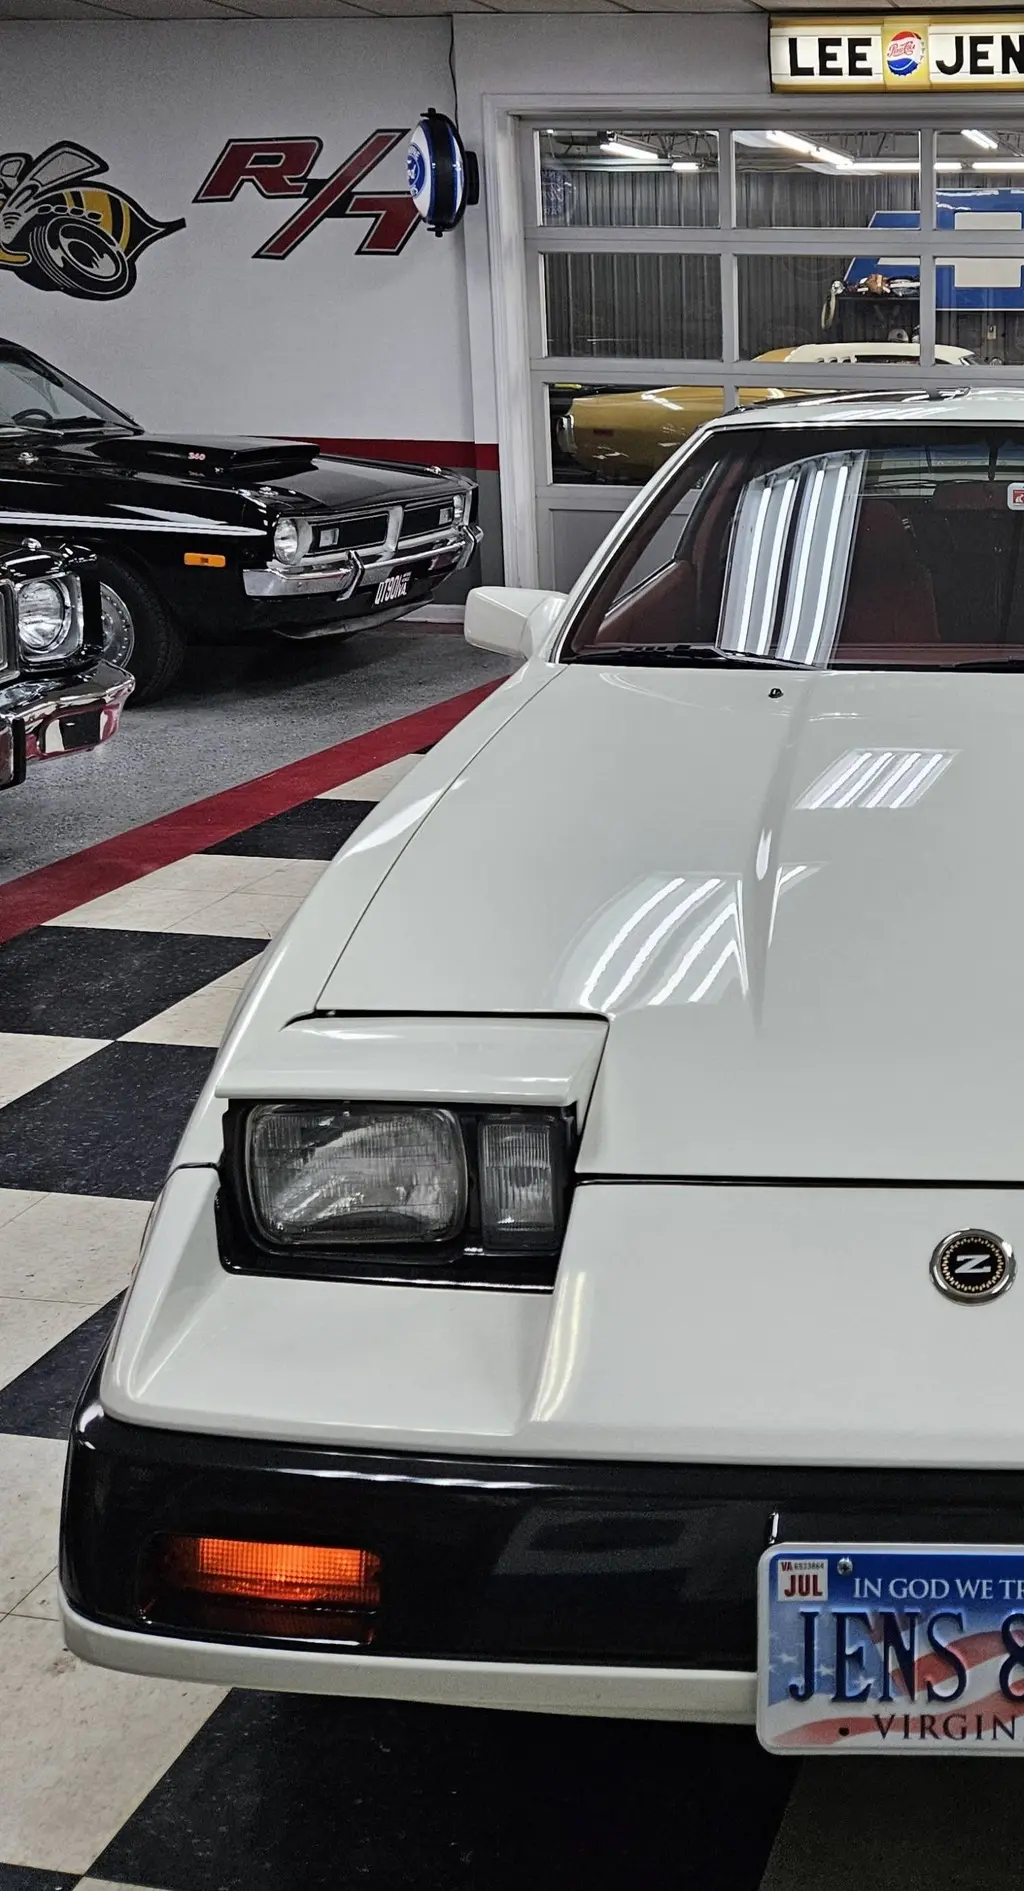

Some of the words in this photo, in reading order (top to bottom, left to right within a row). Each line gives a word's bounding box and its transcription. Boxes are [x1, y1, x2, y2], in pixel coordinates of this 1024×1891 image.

[788, 37, 873, 76] LEE
[192, 128, 421, 260] R/T
[954, 1254, 992, 1274] Z
[781, 1561, 793, 1571] VA
[784, 1574, 823, 1597] JUL
[853, 1578, 881, 1599] IN
[888, 1578, 950, 1600] GOD
[955, 1579, 993, 1600] WE
[788, 1610, 968, 1703] JENS
